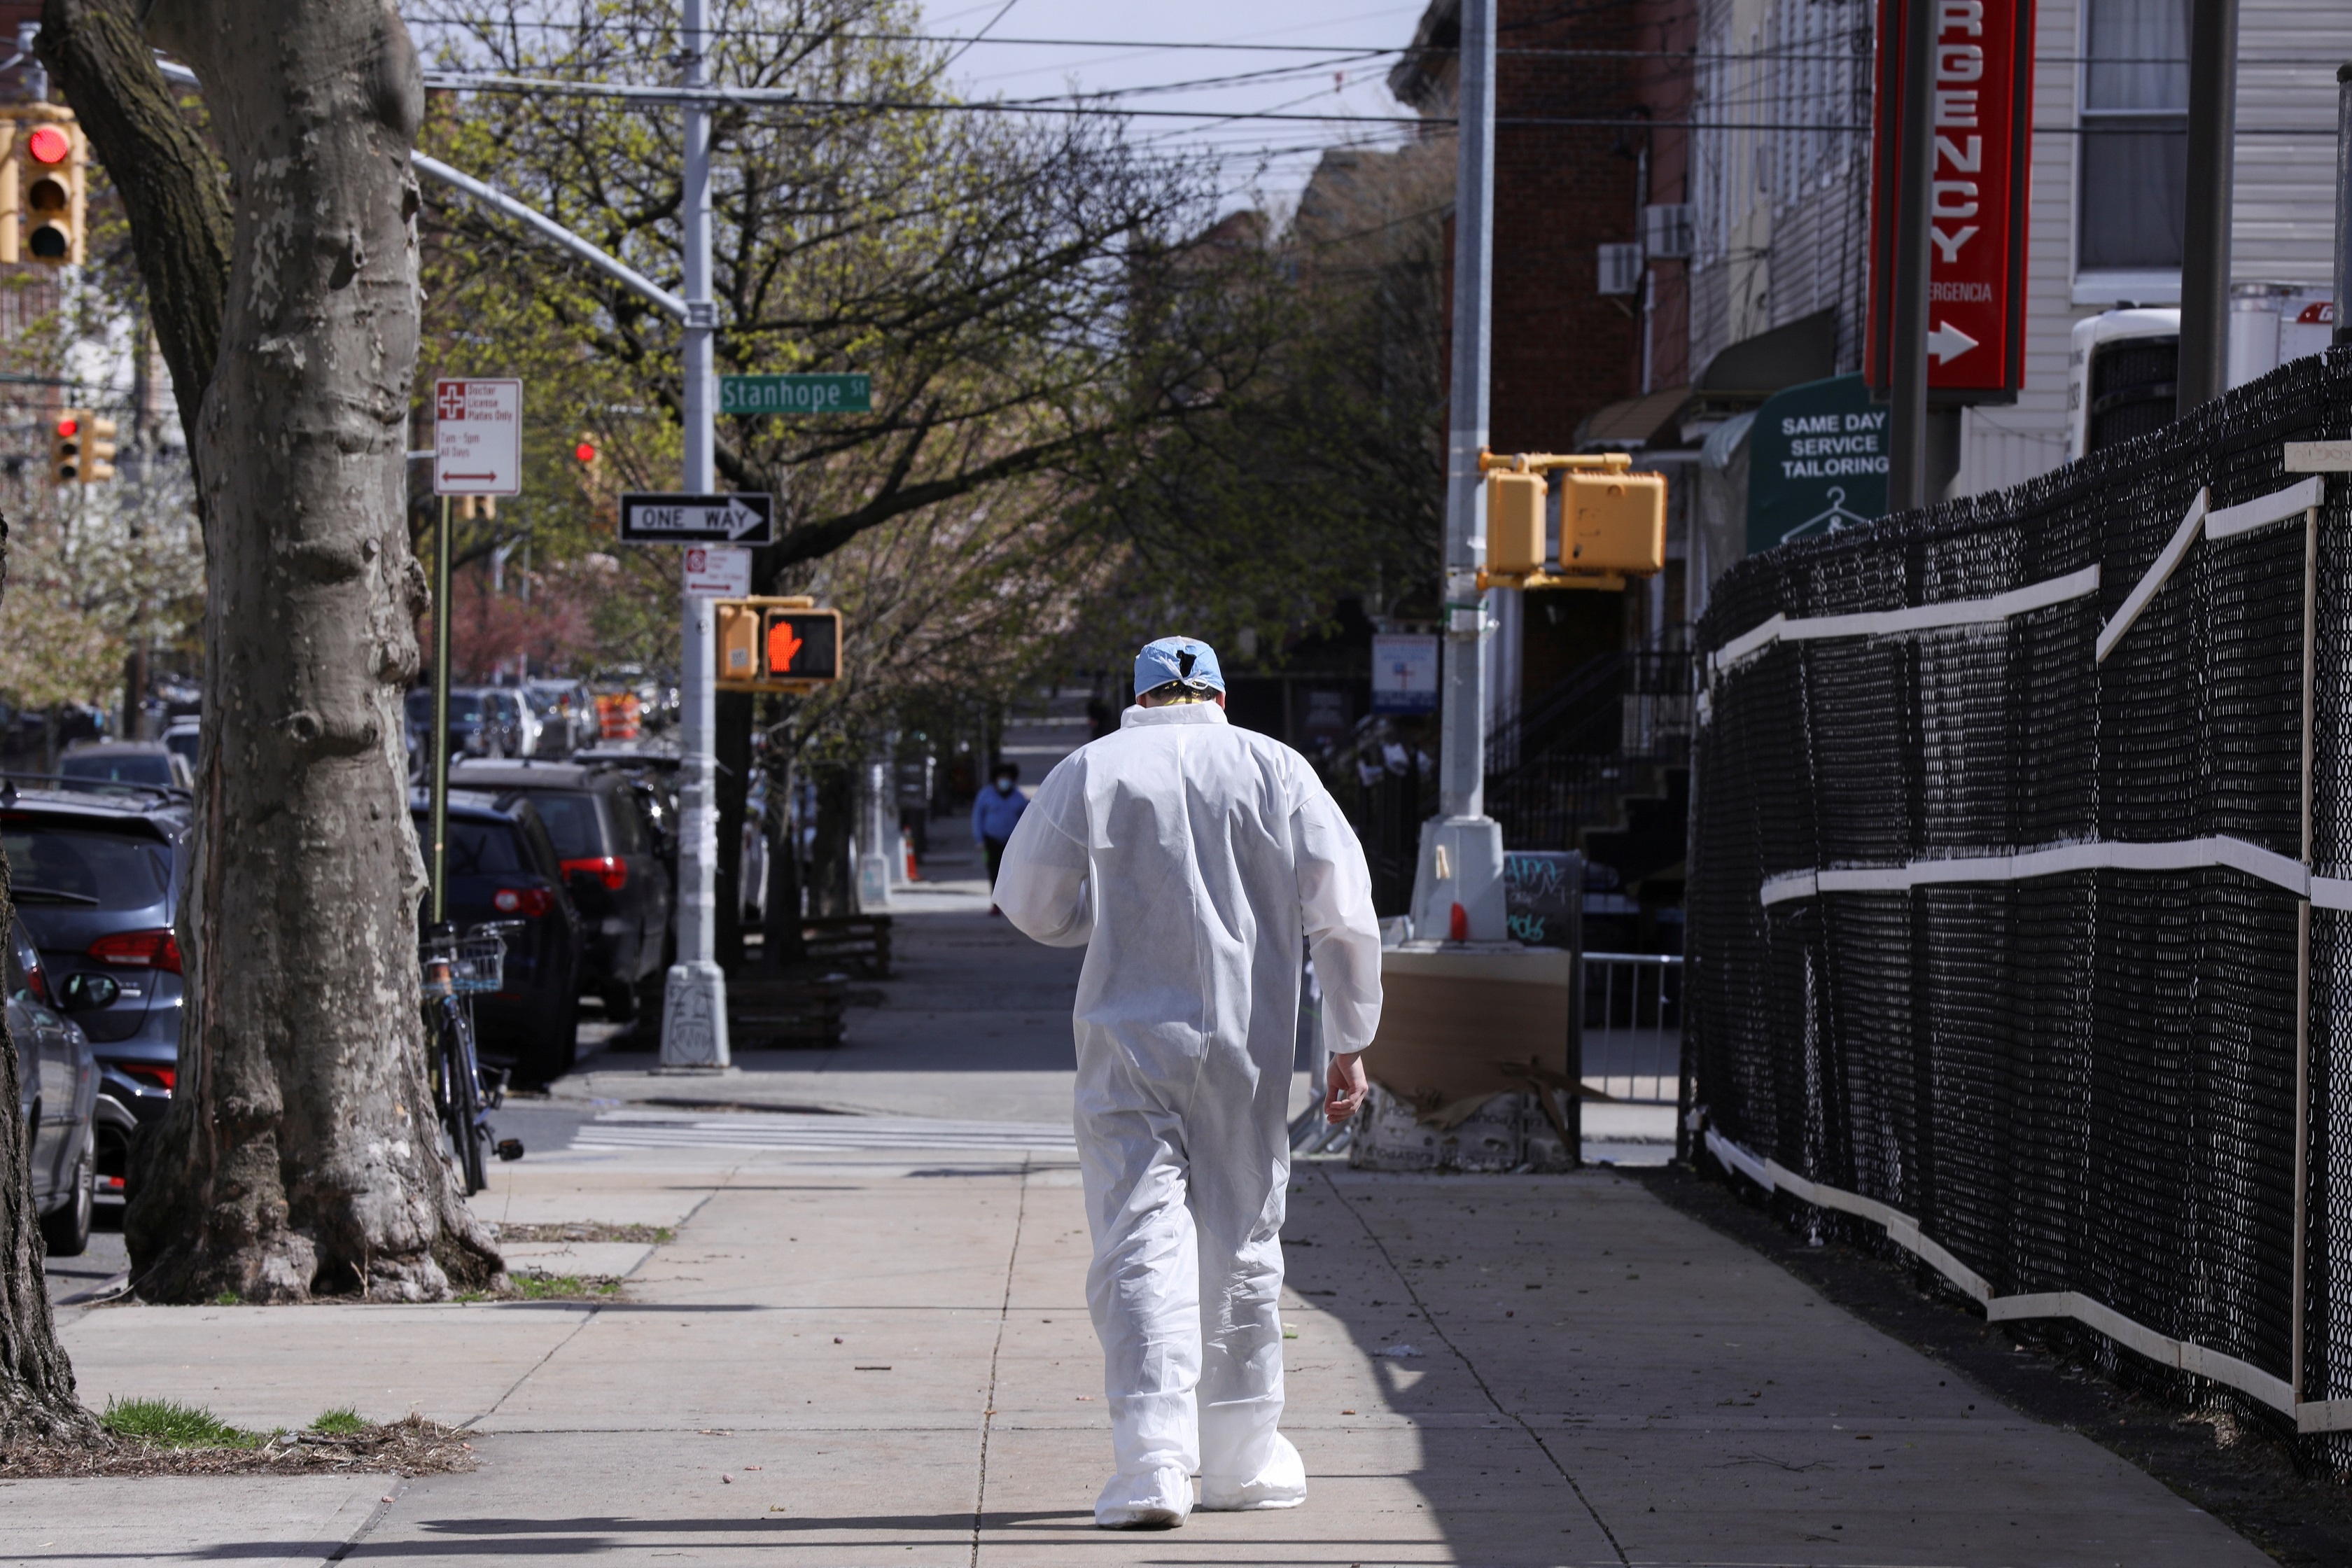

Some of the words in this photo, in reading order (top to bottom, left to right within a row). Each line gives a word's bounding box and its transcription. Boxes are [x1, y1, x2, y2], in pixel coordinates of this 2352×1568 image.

[468, 386, 496, 396] Doctor
[724, 379, 840, 413] Stanhope
[850, 379, 865, 397] St
[468, 398, 498, 408] License
[468, 410, 493, 420] Plates
[495, 410, 512, 423] Only
[1782, 414, 1840, 435] SAME
[1845, 412, 1886, 431] DAY
[1791, 435, 1879, 456] SERVICE
[1782, 456, 1889, 479] TAILORING
[642, 508, 684, 528] ONE
[704, 509, 750, 528] WAY
